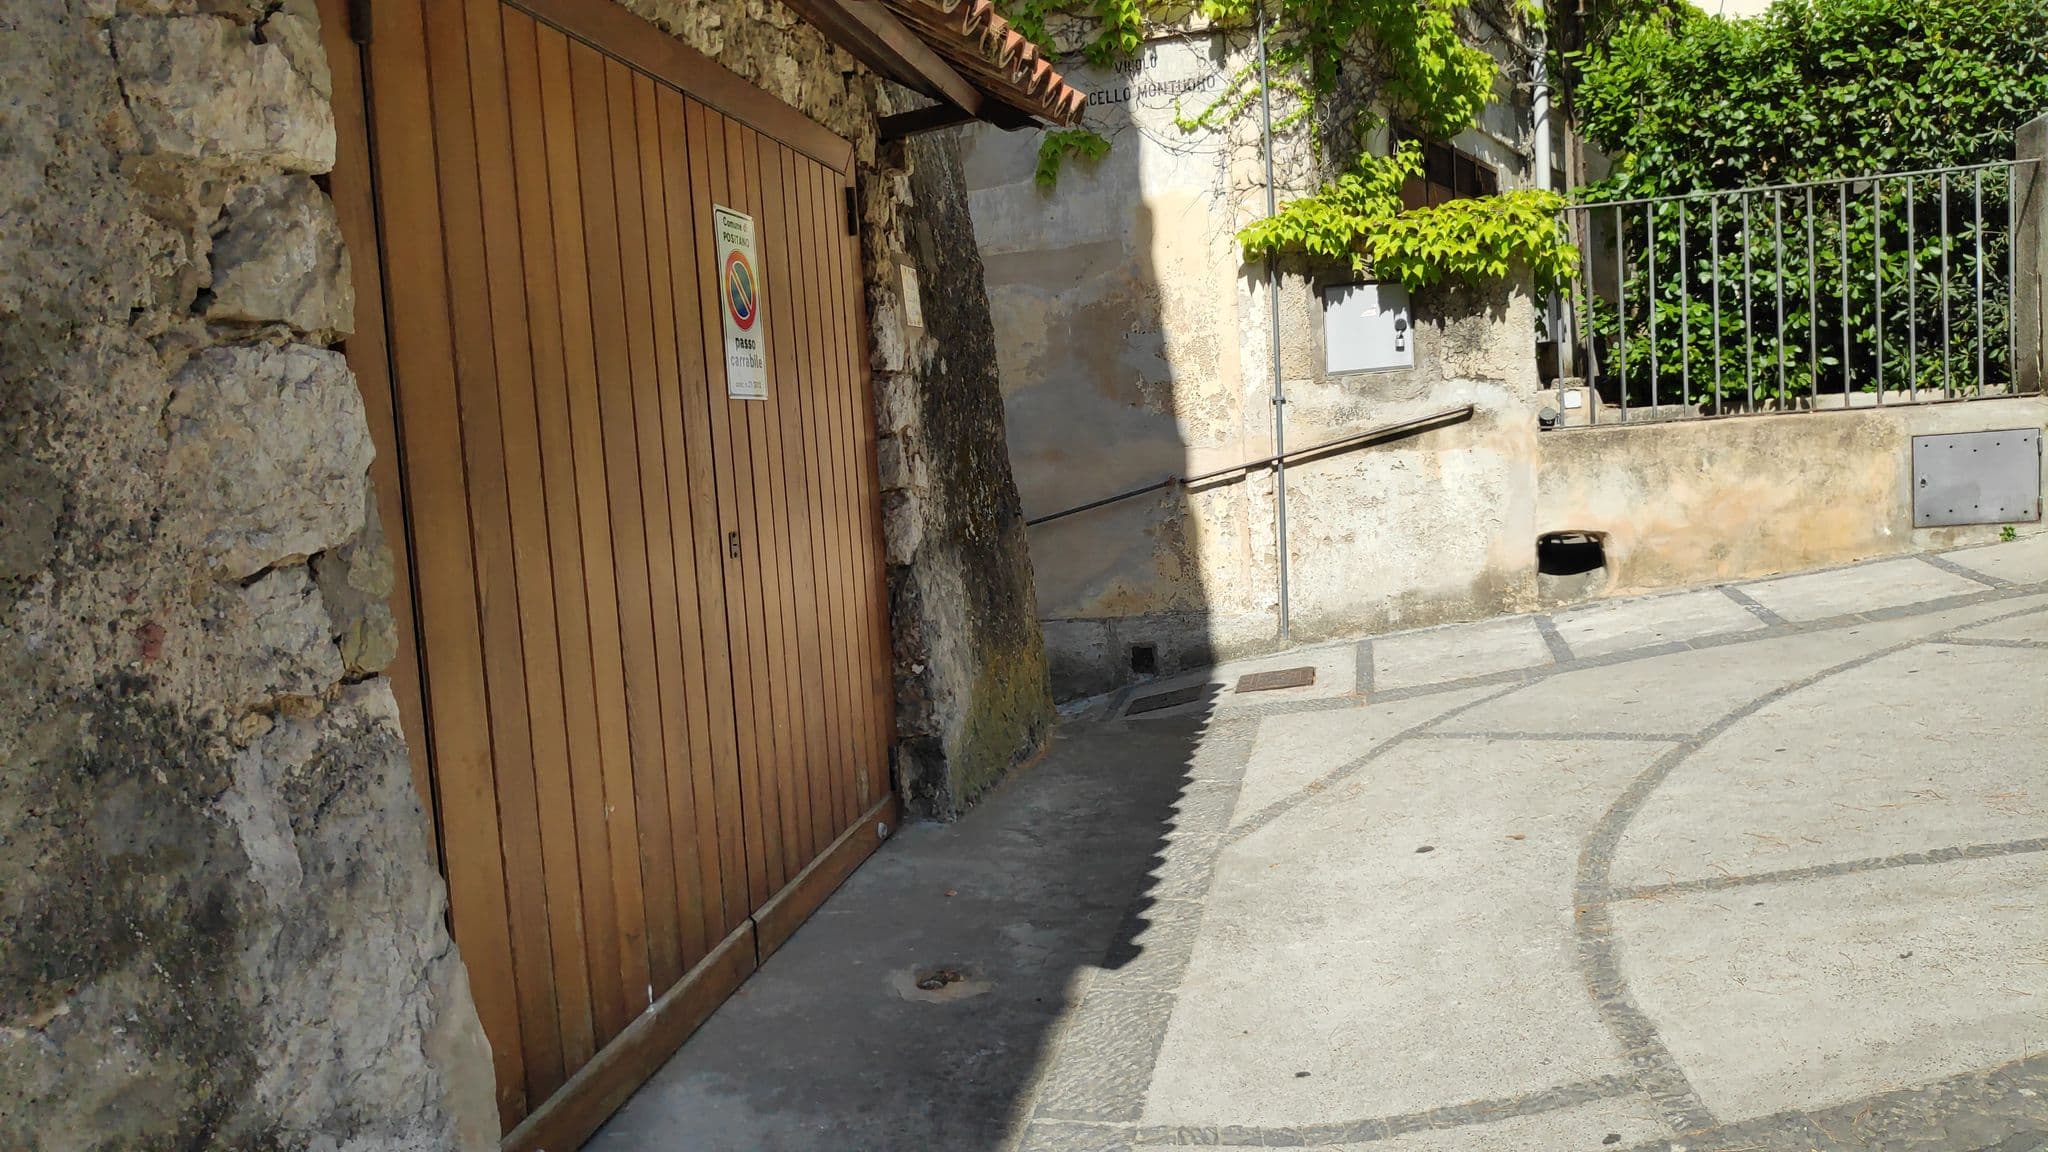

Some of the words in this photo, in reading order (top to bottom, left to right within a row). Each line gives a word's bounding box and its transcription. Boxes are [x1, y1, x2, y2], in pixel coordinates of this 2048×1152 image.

[1114, 53, 1157, 73] VICOLO
[722, 216, 742, 231] Comune
[723, 231, 750, 248] POSITANO
[735, 337, 756, 351] passo
[730, 353, 763, 368] carrabile
